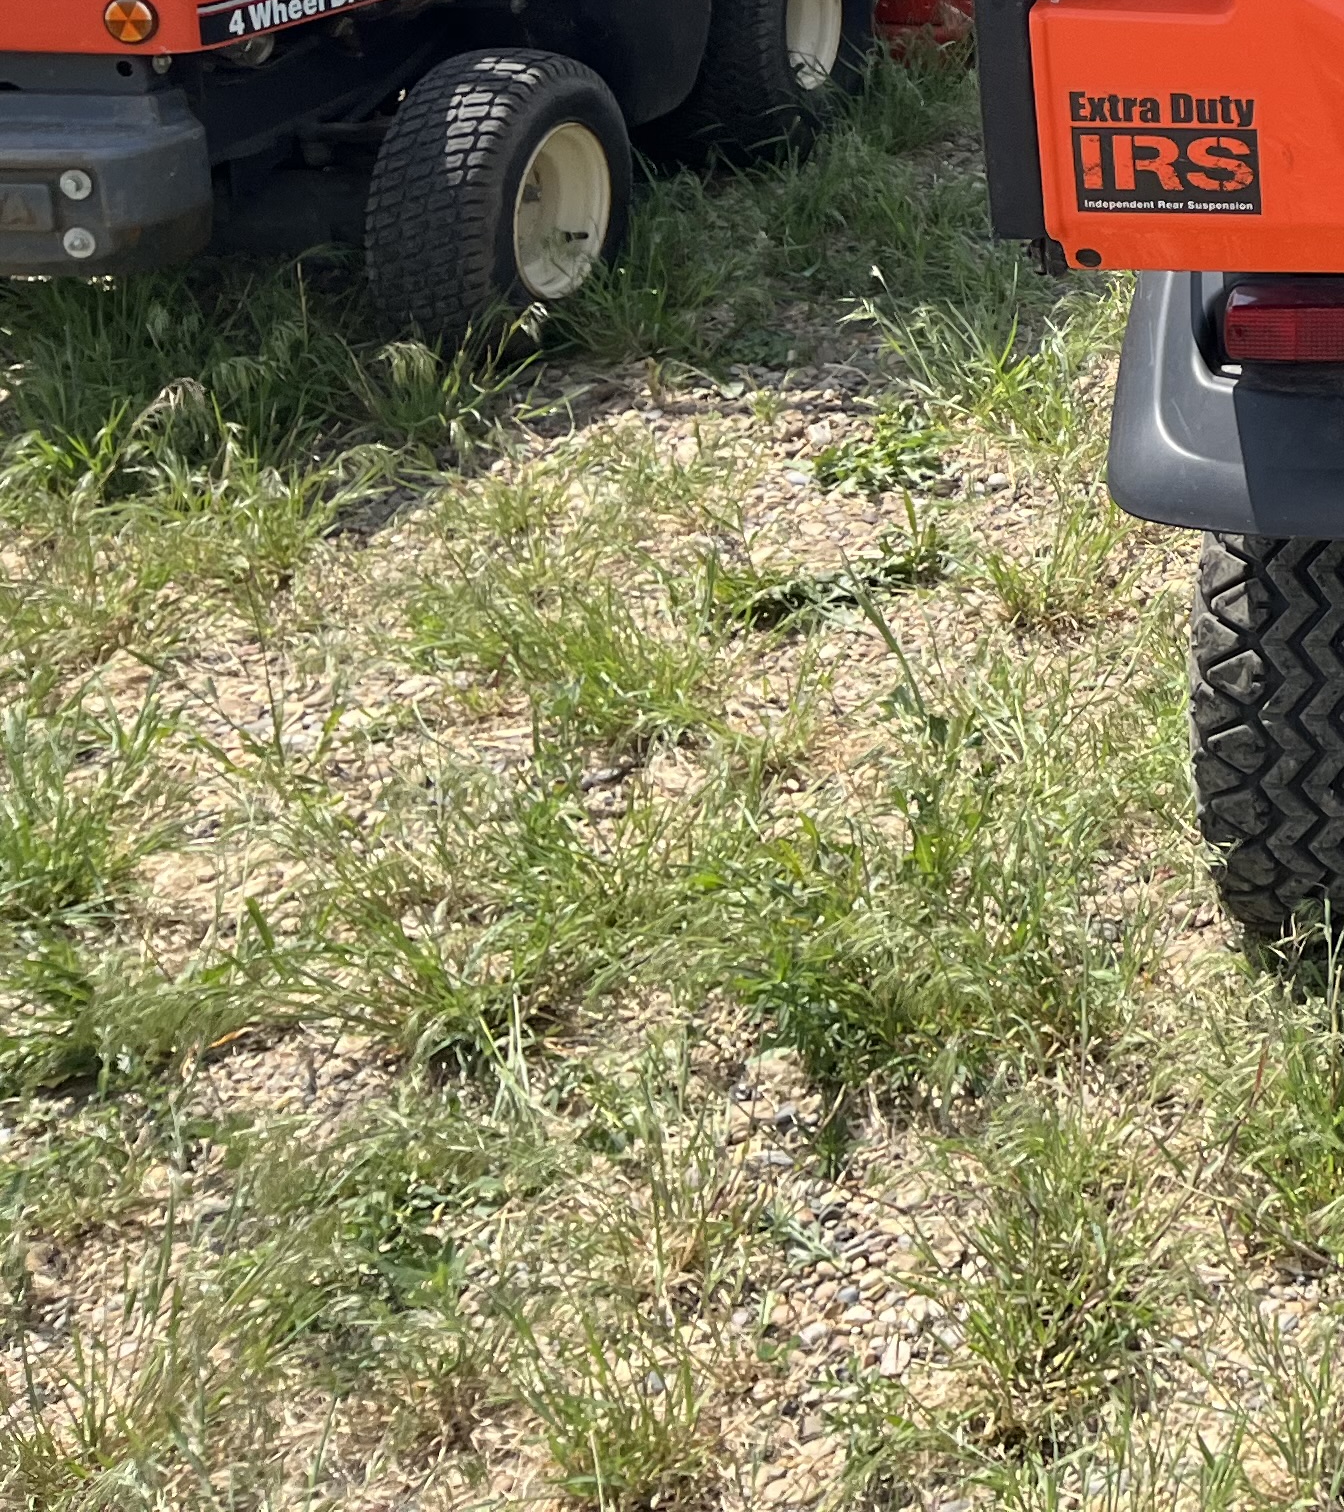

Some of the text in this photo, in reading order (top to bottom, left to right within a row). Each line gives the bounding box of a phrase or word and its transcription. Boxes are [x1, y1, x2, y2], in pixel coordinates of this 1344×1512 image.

[228, 8, 246, 36] 4
[1069, 91, 1255, 128] Extra Duty
[1079, 134, 1255, 192] IRS
[1084, 199, 1254, 212] Independent Rear Suspension
